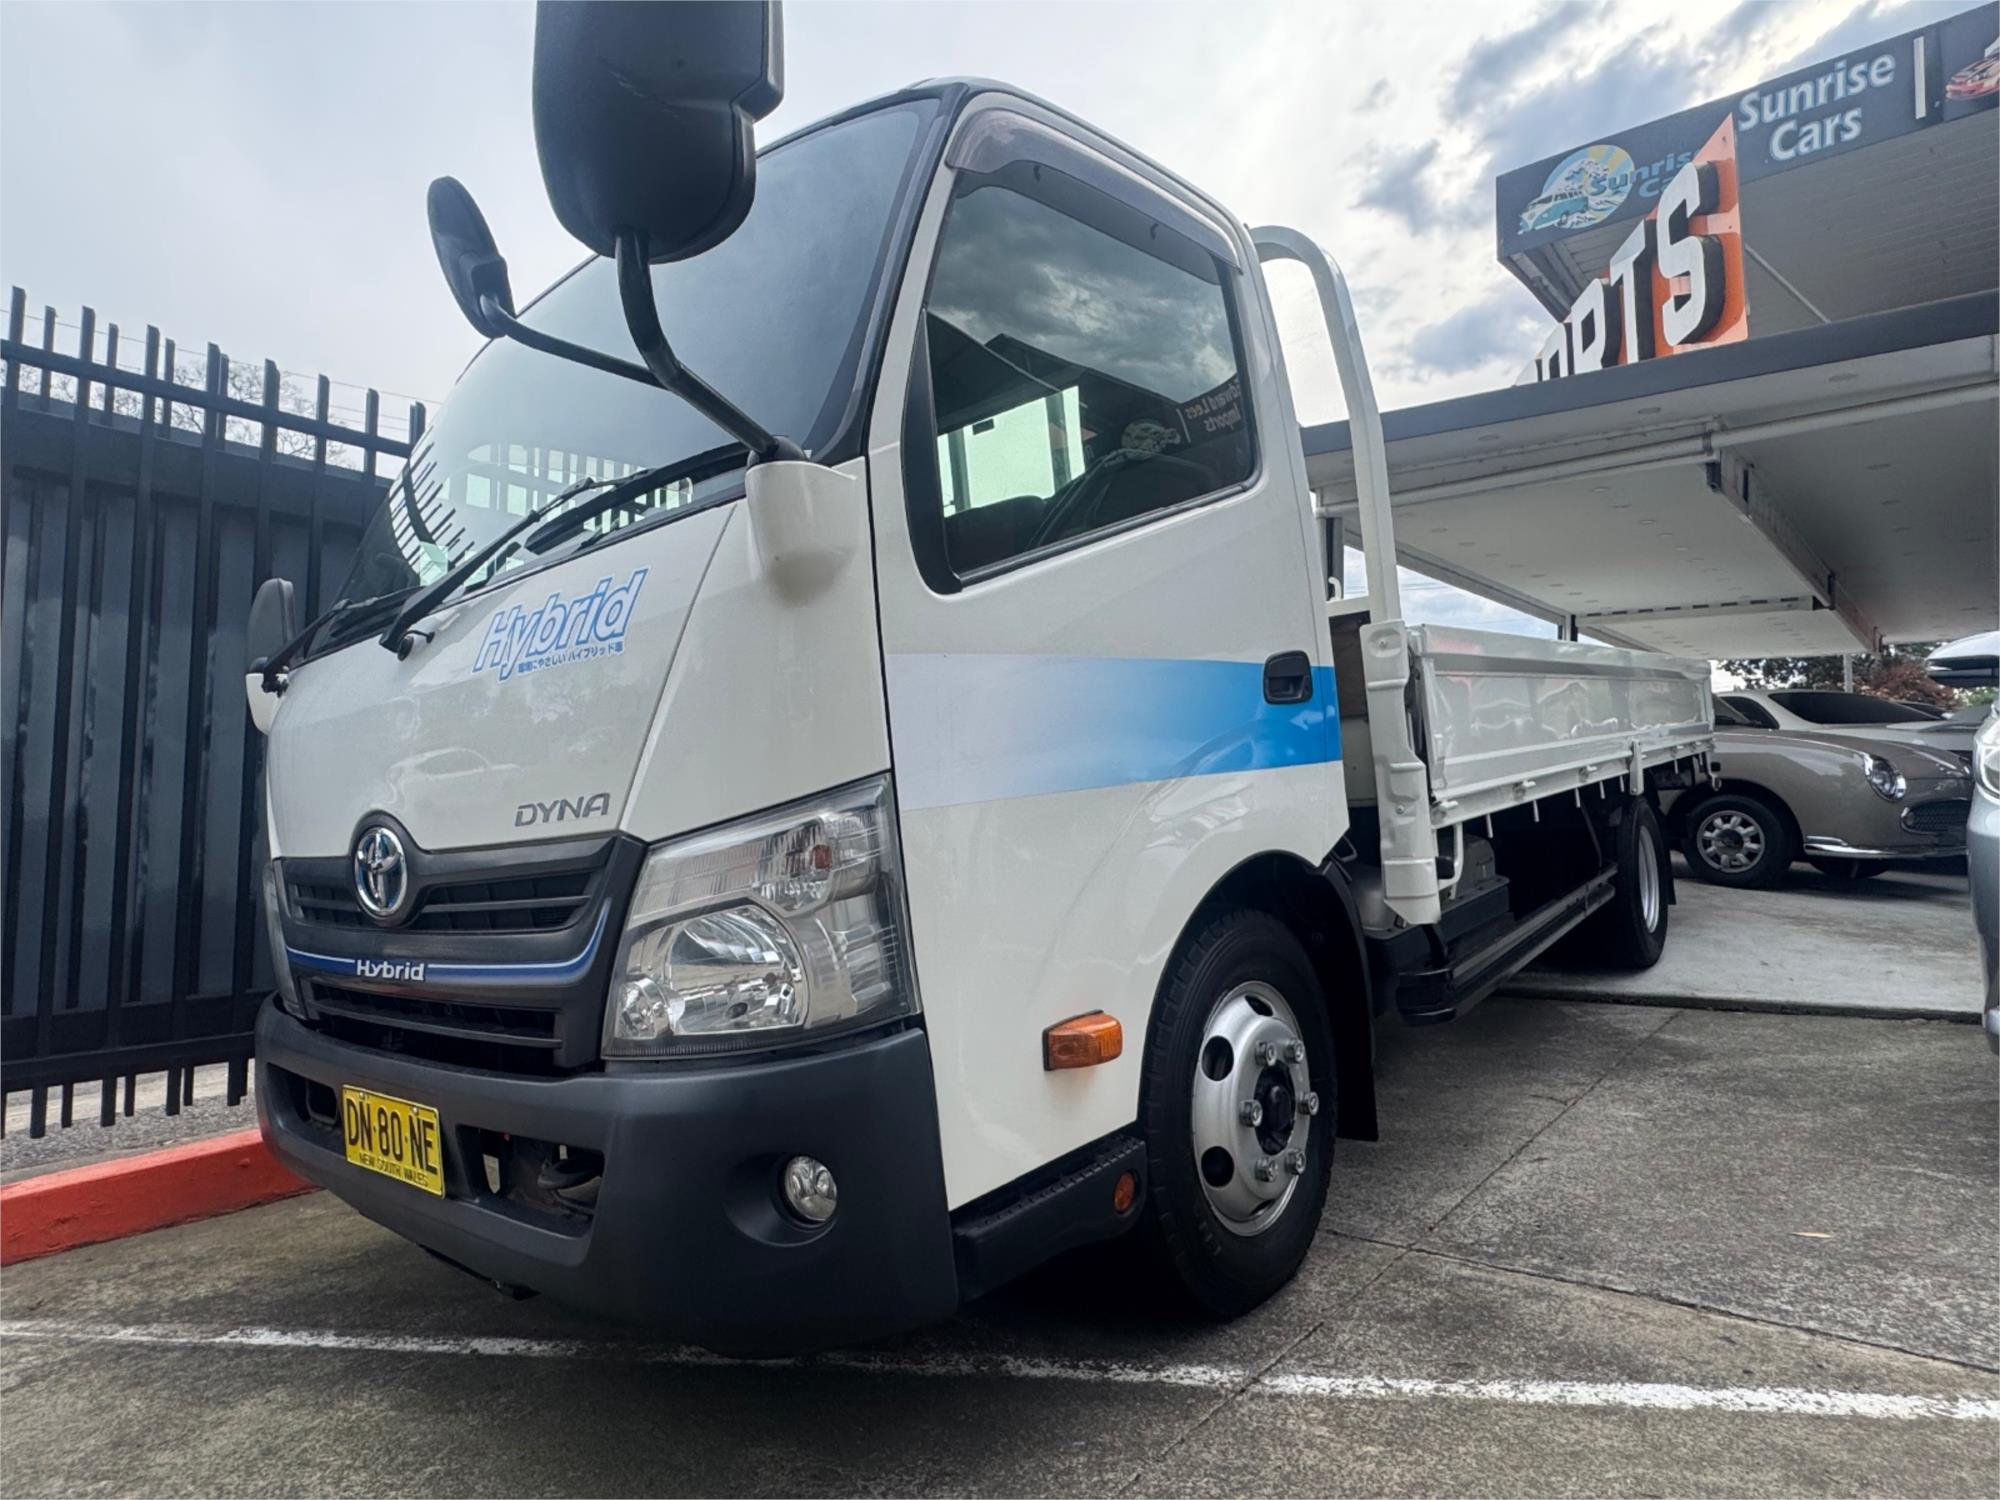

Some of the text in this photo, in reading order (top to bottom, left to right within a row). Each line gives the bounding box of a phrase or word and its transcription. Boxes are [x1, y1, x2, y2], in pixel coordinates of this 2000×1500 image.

[1738, 53, 1896, 132] Sunrise
[1770, 106, 1863, 161] Cars
[1590, 151, 1697, 196] Sunris
[472, 566, 650, 682] Hybrid
[514, 792, 611, 827] DYNA
[356, 959, 425, 981] Hybrid
